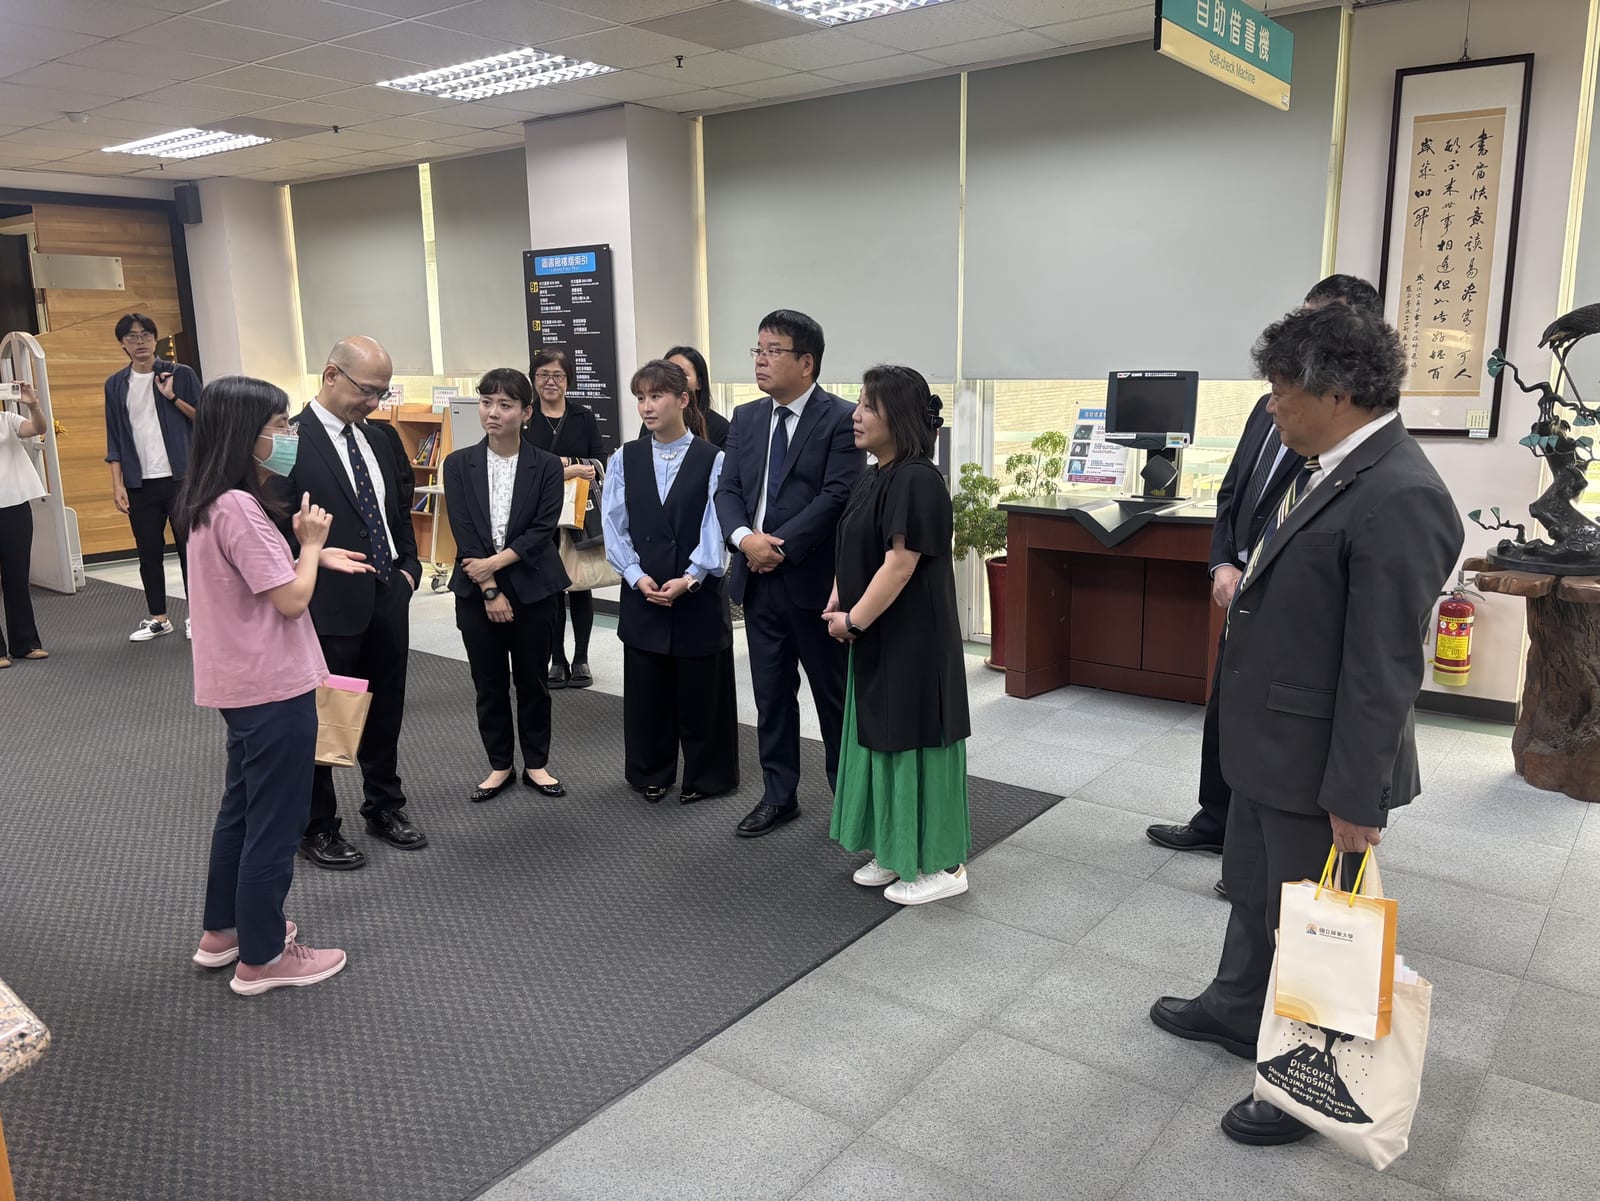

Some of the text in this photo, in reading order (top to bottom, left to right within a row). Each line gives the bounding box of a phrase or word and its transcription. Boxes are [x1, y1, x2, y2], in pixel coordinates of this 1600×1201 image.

[1196, 0, 1270, 62] 自助借書機
[1208, 49, 1256, 84] Self-check Machine
[1287, 1067, 1336, 1097] KAGOSHIMA
[1290, 1058, 1335, 1085] DISCOVER
[1292, 1086, 1314, 1102] Energy
[1334, 1107, 1353, 1119] Earth
